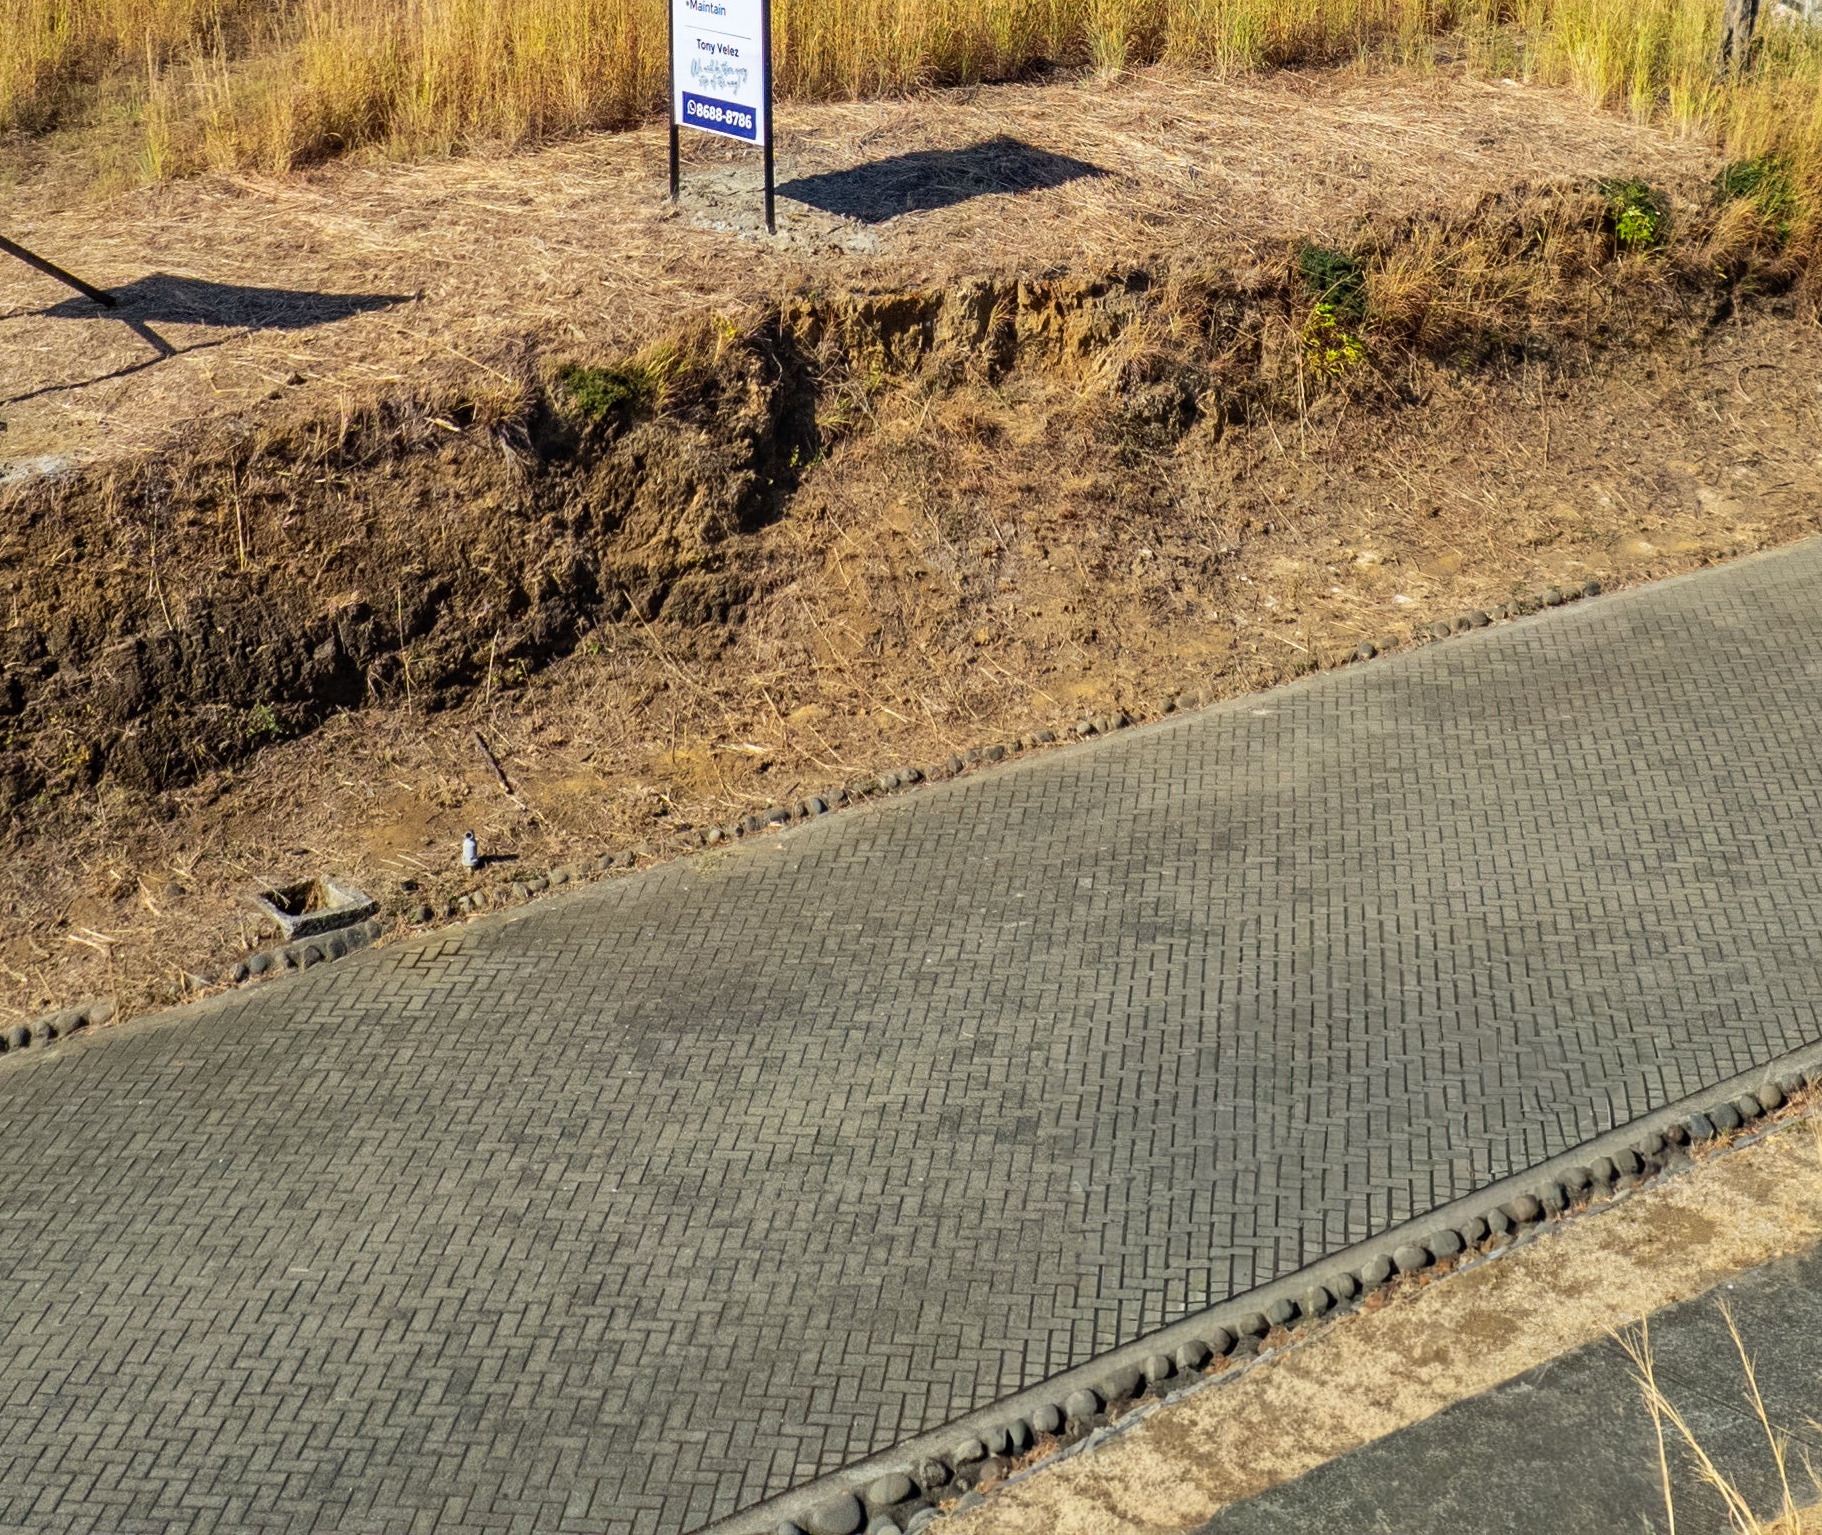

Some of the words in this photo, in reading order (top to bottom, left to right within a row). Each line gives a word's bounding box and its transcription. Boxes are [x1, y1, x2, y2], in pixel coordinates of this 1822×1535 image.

[689, 0, 726, 16] Maintain
[696, 38, 715, 55] Tony
[717, 43, 739, 57] Velez
[696, 102, 752, 129] 8688-8786
